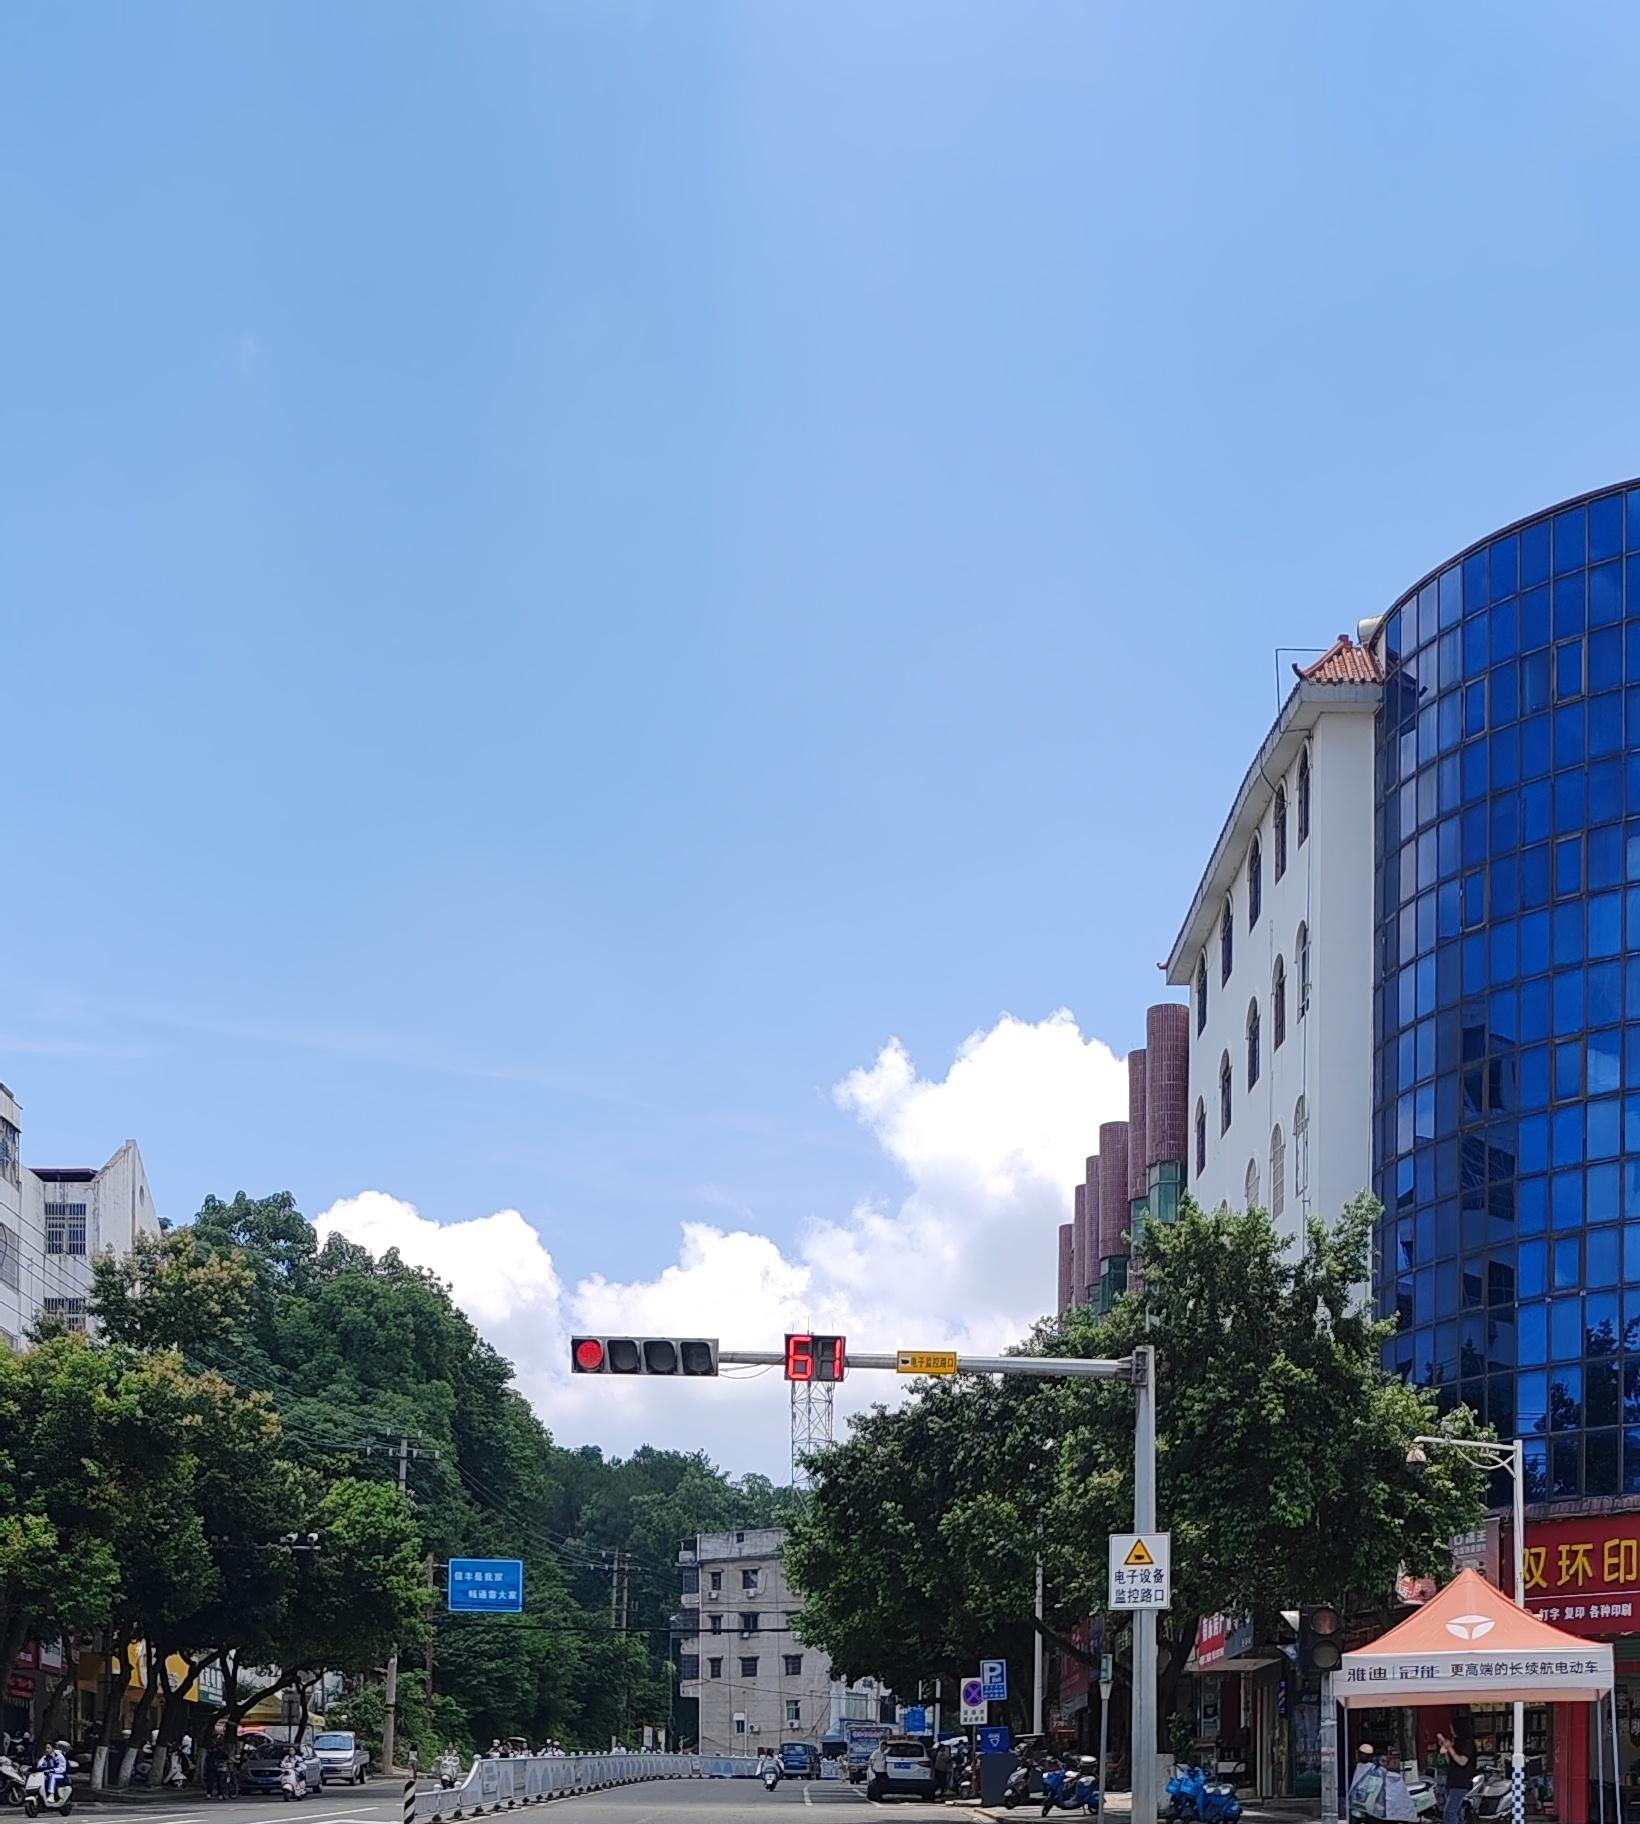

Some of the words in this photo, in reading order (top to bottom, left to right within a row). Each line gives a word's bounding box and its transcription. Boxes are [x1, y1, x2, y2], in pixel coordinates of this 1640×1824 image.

[788, 1336, 843, 1380] 61
[911, 1357, 954, 1368] 电子监控路口
[1114, 1568, 1164, 1584] 电子设备
[1114, 1588, 1164, 1604] 监控路口
[1564, 1606, 1585, 1620] 复印
[1589, 1603, 1632, 1618] 各种印刷
[1347, 1665, 1388, 1682] 雅迪
[1399, 1665, 1439, 1680] 冠能
[1450, 1660, 1599, 1678] 更高端的长续航电动车
